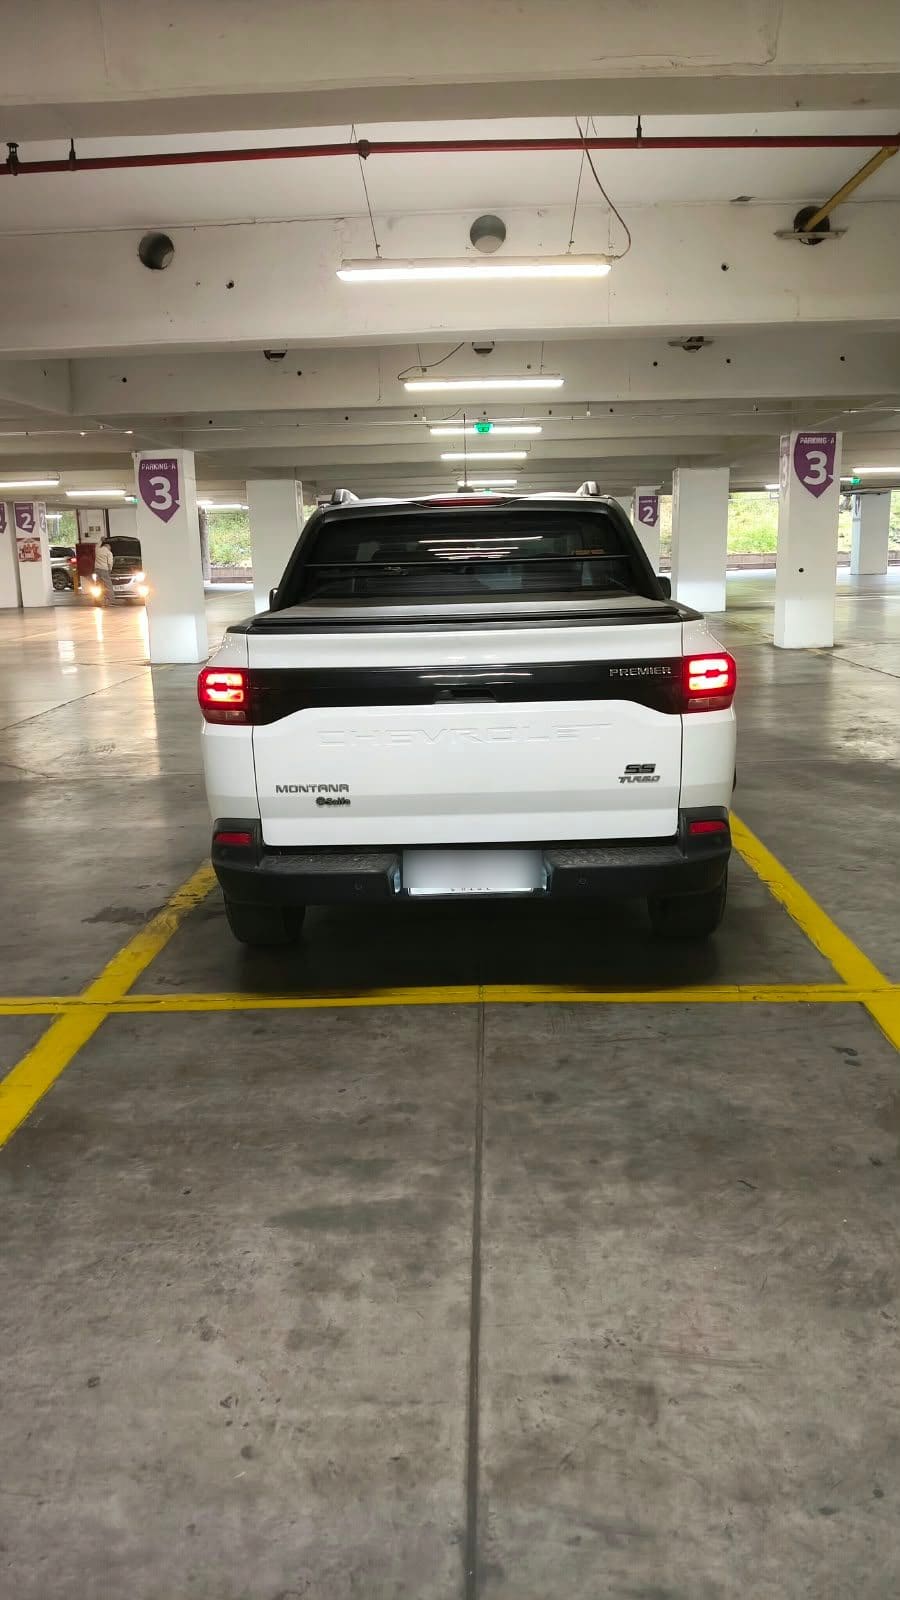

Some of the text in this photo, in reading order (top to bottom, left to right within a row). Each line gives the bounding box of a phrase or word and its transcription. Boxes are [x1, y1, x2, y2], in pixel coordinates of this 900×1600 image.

[803, 450, 828, 486] 3
[149, 476, 173, 511] 3
[20, 512, 33, 529] 2
[643, 505, 654, 522] 2
[609, 666, 672, 677] PREMIER
[317, 723, 612, 746] CHEVROLET
[623, 763, 657, 774] SS
[275, 783, 350, 794] MONTANA
